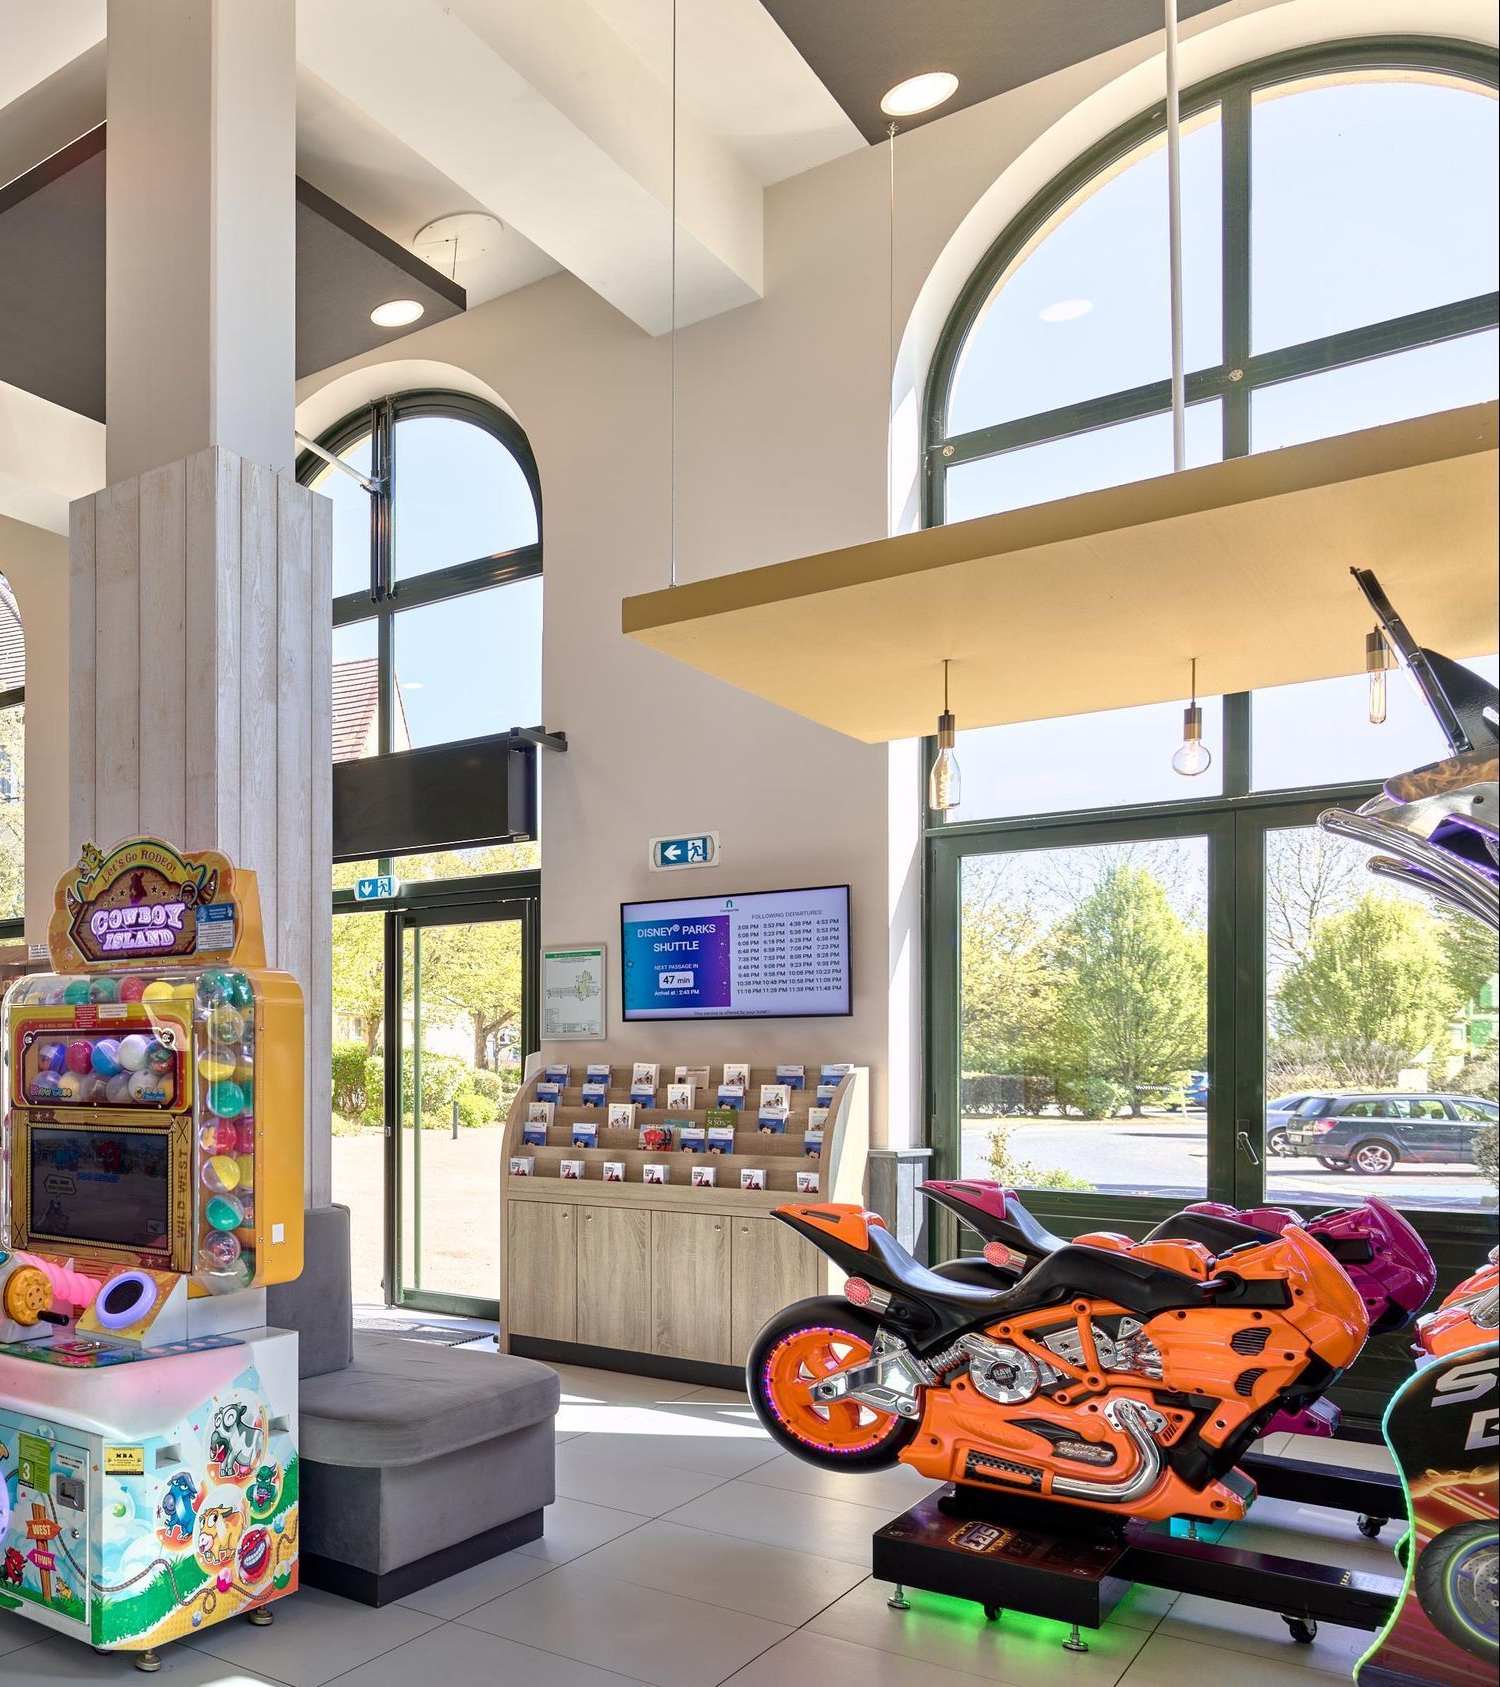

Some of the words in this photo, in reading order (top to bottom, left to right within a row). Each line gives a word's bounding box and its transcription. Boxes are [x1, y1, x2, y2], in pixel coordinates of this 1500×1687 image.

[91, 903, 186, 935] COWBOY
[682, 924, 716, 935] PARKS
[103, 929, 175, 950] ISLAND
[653, 941, 699, 952] SHUTTLE
[663, 976, 675, 984] 47
[677, 976, 691, 984] min
[178, 1149, 187, 1193] WEST
[177, 1201, 185, 1238] WILD
[22, 1462, 30, 1480] 3
[32, 1524, 50, 1535] WEST
[34, 1553, 52, 1566] TOWN
